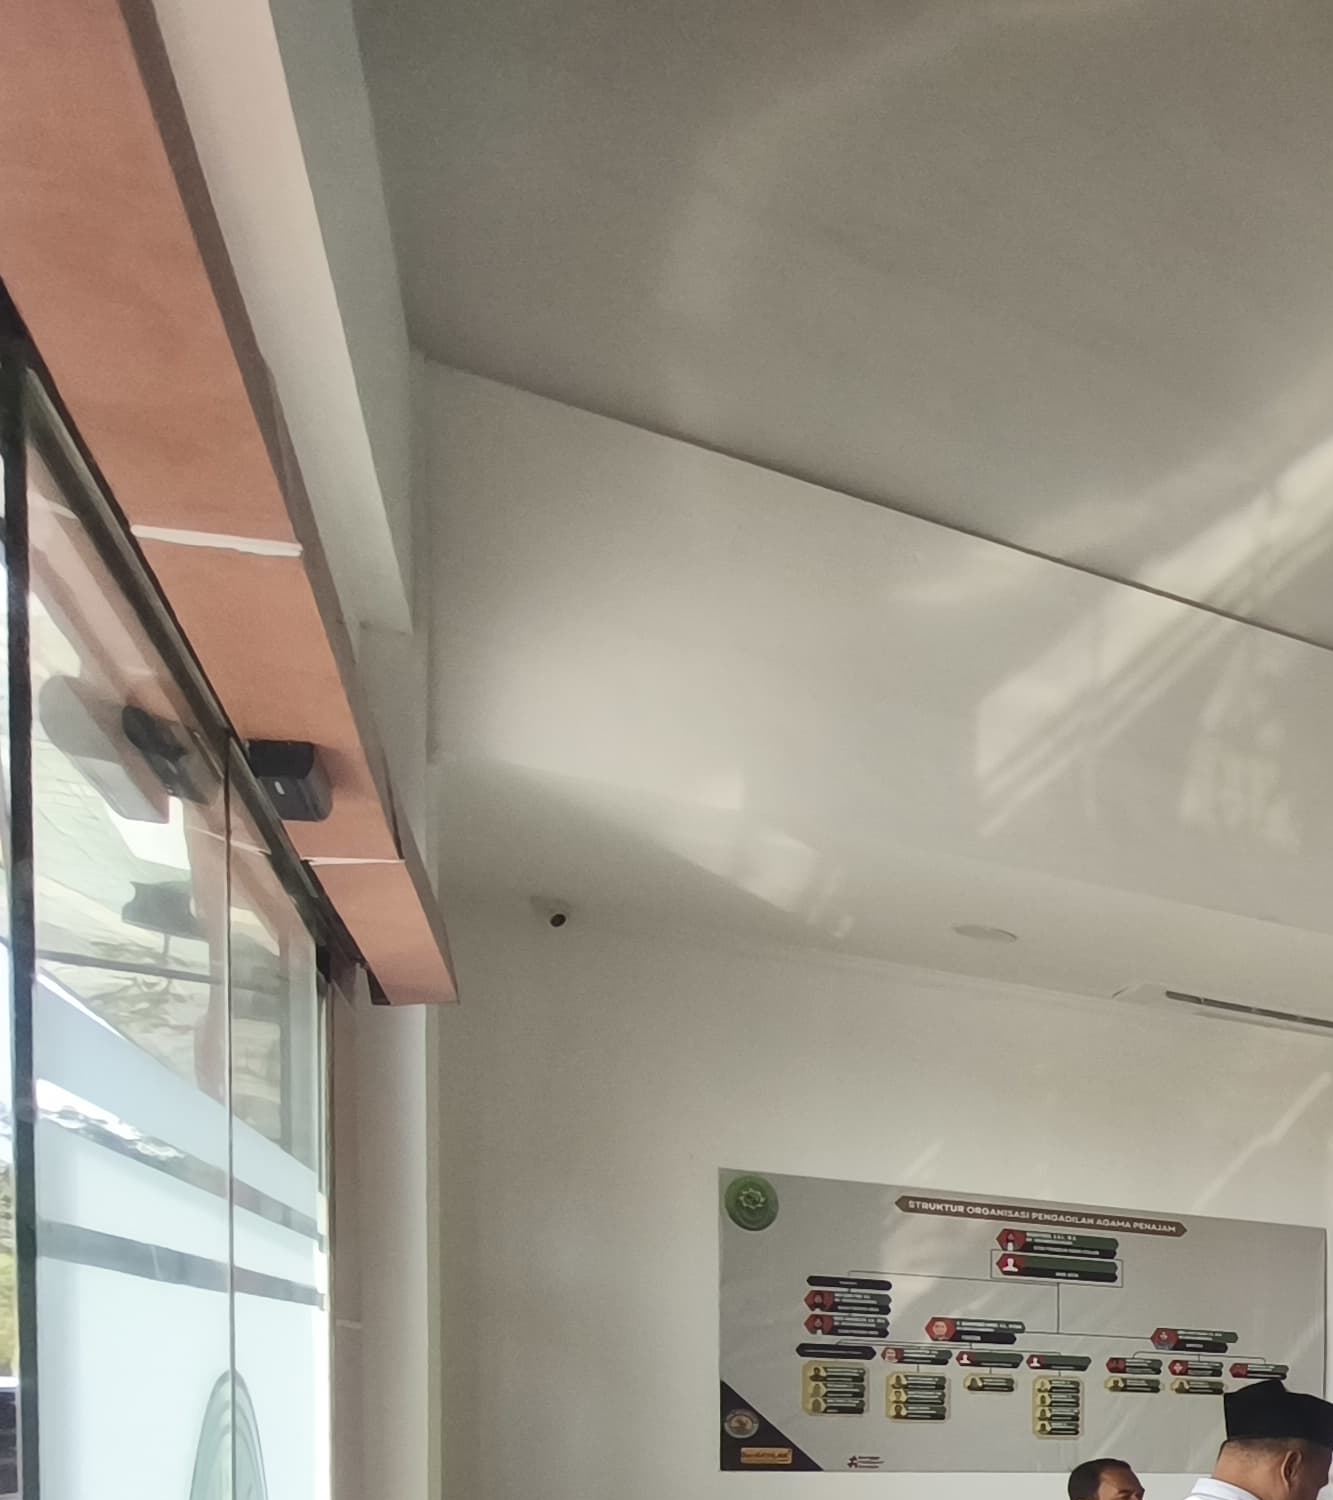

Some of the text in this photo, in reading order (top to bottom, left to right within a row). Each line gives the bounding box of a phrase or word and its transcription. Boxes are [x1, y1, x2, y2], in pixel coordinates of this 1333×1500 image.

[908, 1200, 965, 1213] STRUKTUR
[966, 1206, 1030, 1219] ORGANISASI
[1031, 1211, 1094, 1225] PENGADILAN
[1132, 1222, 1176, 1232] PENAJAM
